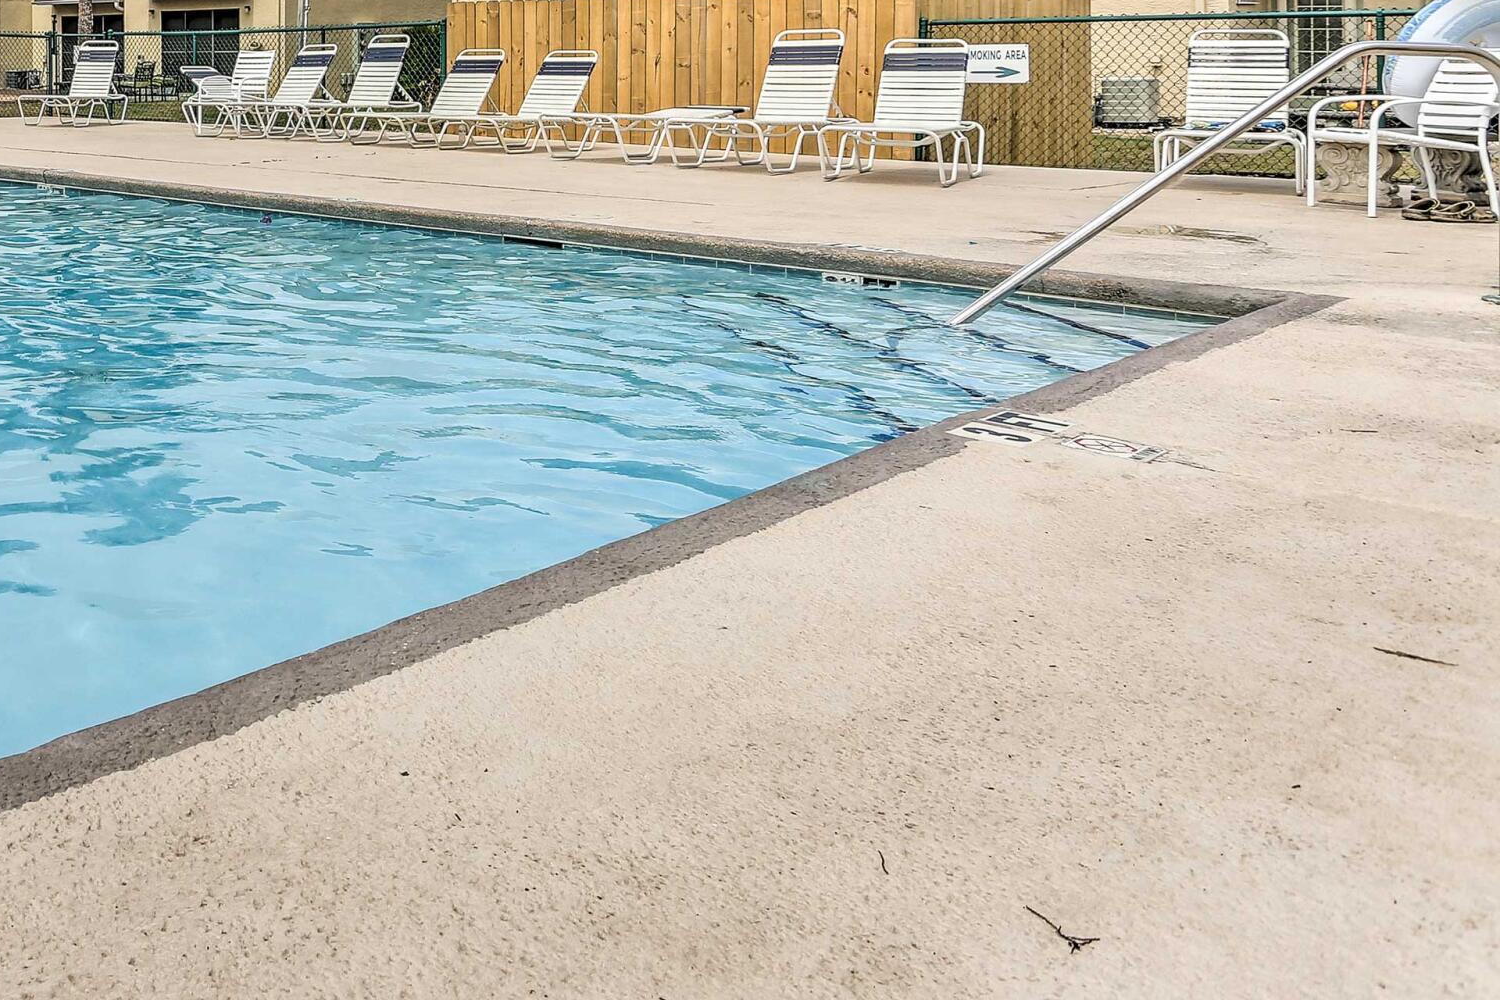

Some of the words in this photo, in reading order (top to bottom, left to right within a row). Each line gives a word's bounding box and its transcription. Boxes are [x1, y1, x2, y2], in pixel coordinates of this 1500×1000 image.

[969, 49, 1002, 60] MOKING
[1004, 49, 1027, 60] AREA
[986, 411, 1070, 433] FT
